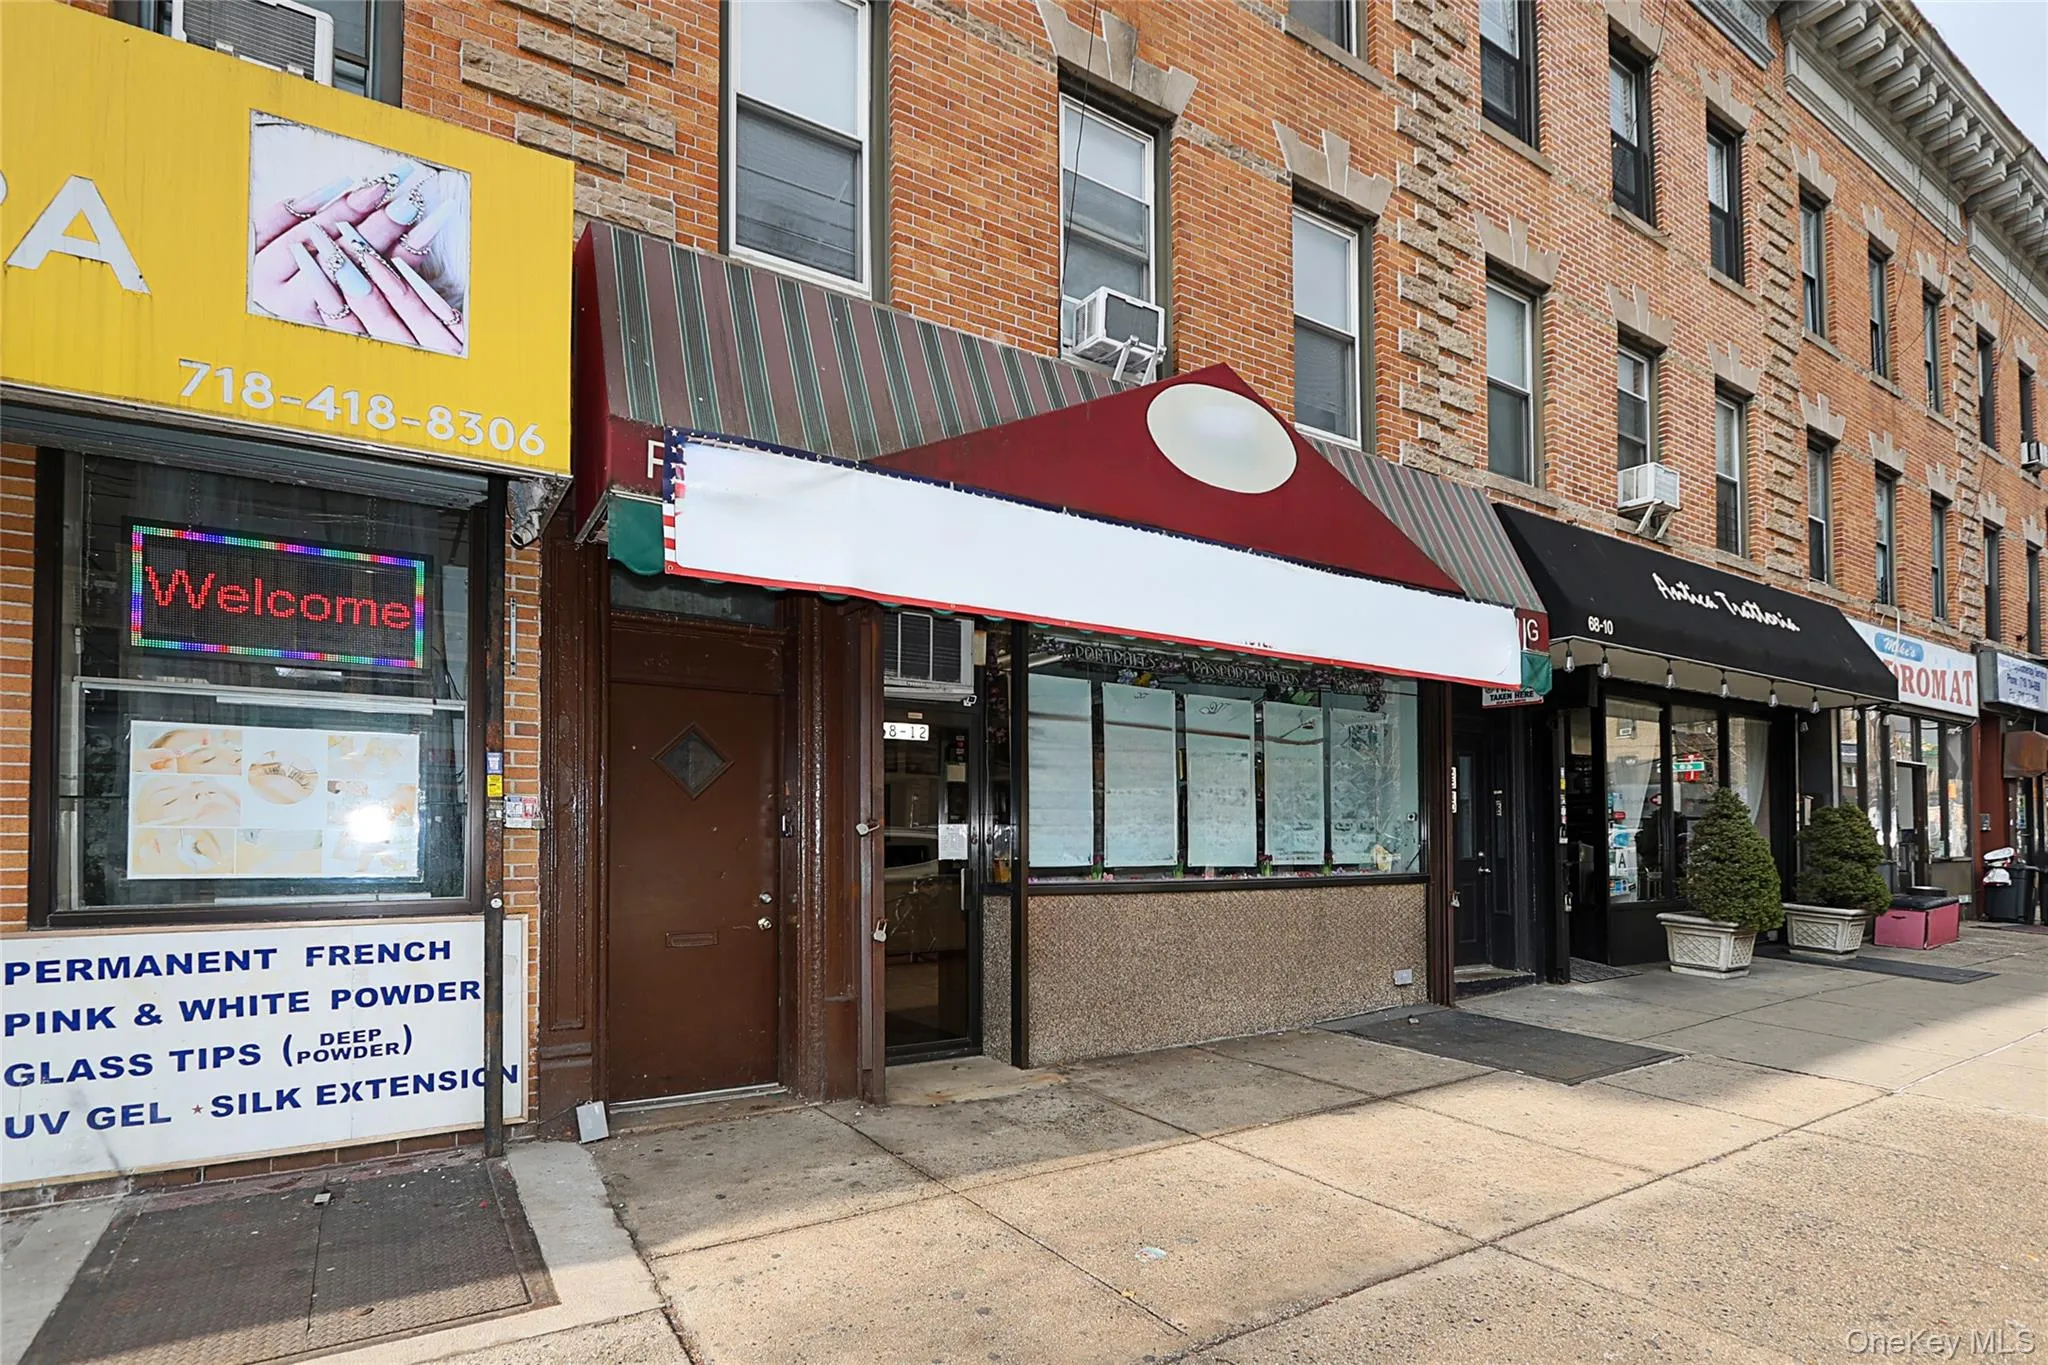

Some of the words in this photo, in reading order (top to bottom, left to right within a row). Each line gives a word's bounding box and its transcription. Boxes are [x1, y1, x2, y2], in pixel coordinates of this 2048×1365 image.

[0, 168, 151, 296] A
[178, 358, 546, 456] 718-418-8306
[145, 565, 411, 629] Welcome
[1652, 572, 1719, 610] Antica
[1713, 590, 1801, 632] Trattoria
[1587, 615, 1614, 636] 68-10
[1490, 693, 1512, 701] TAKEN
[1514, 690, 1535, 699] HERE
[4, 948, 277, 985] PERMANENT
[306, 940, 451, 967] FRENCH
[4, 1006, 115, 1037] PINK
[134, 1002, 162, 1026] &
[179, 991, 310, 1022] WHITE
[331, 980, 481, 1010] POWDER
[4, 1053, 153, 1087] GLASS
[169, 1043, 262, 1071] TIPS
[4, 1110, 69, 1140] UV
[86, 1102, 172, 1130] GEL
[211, 1087, 302, 1118] SILK
